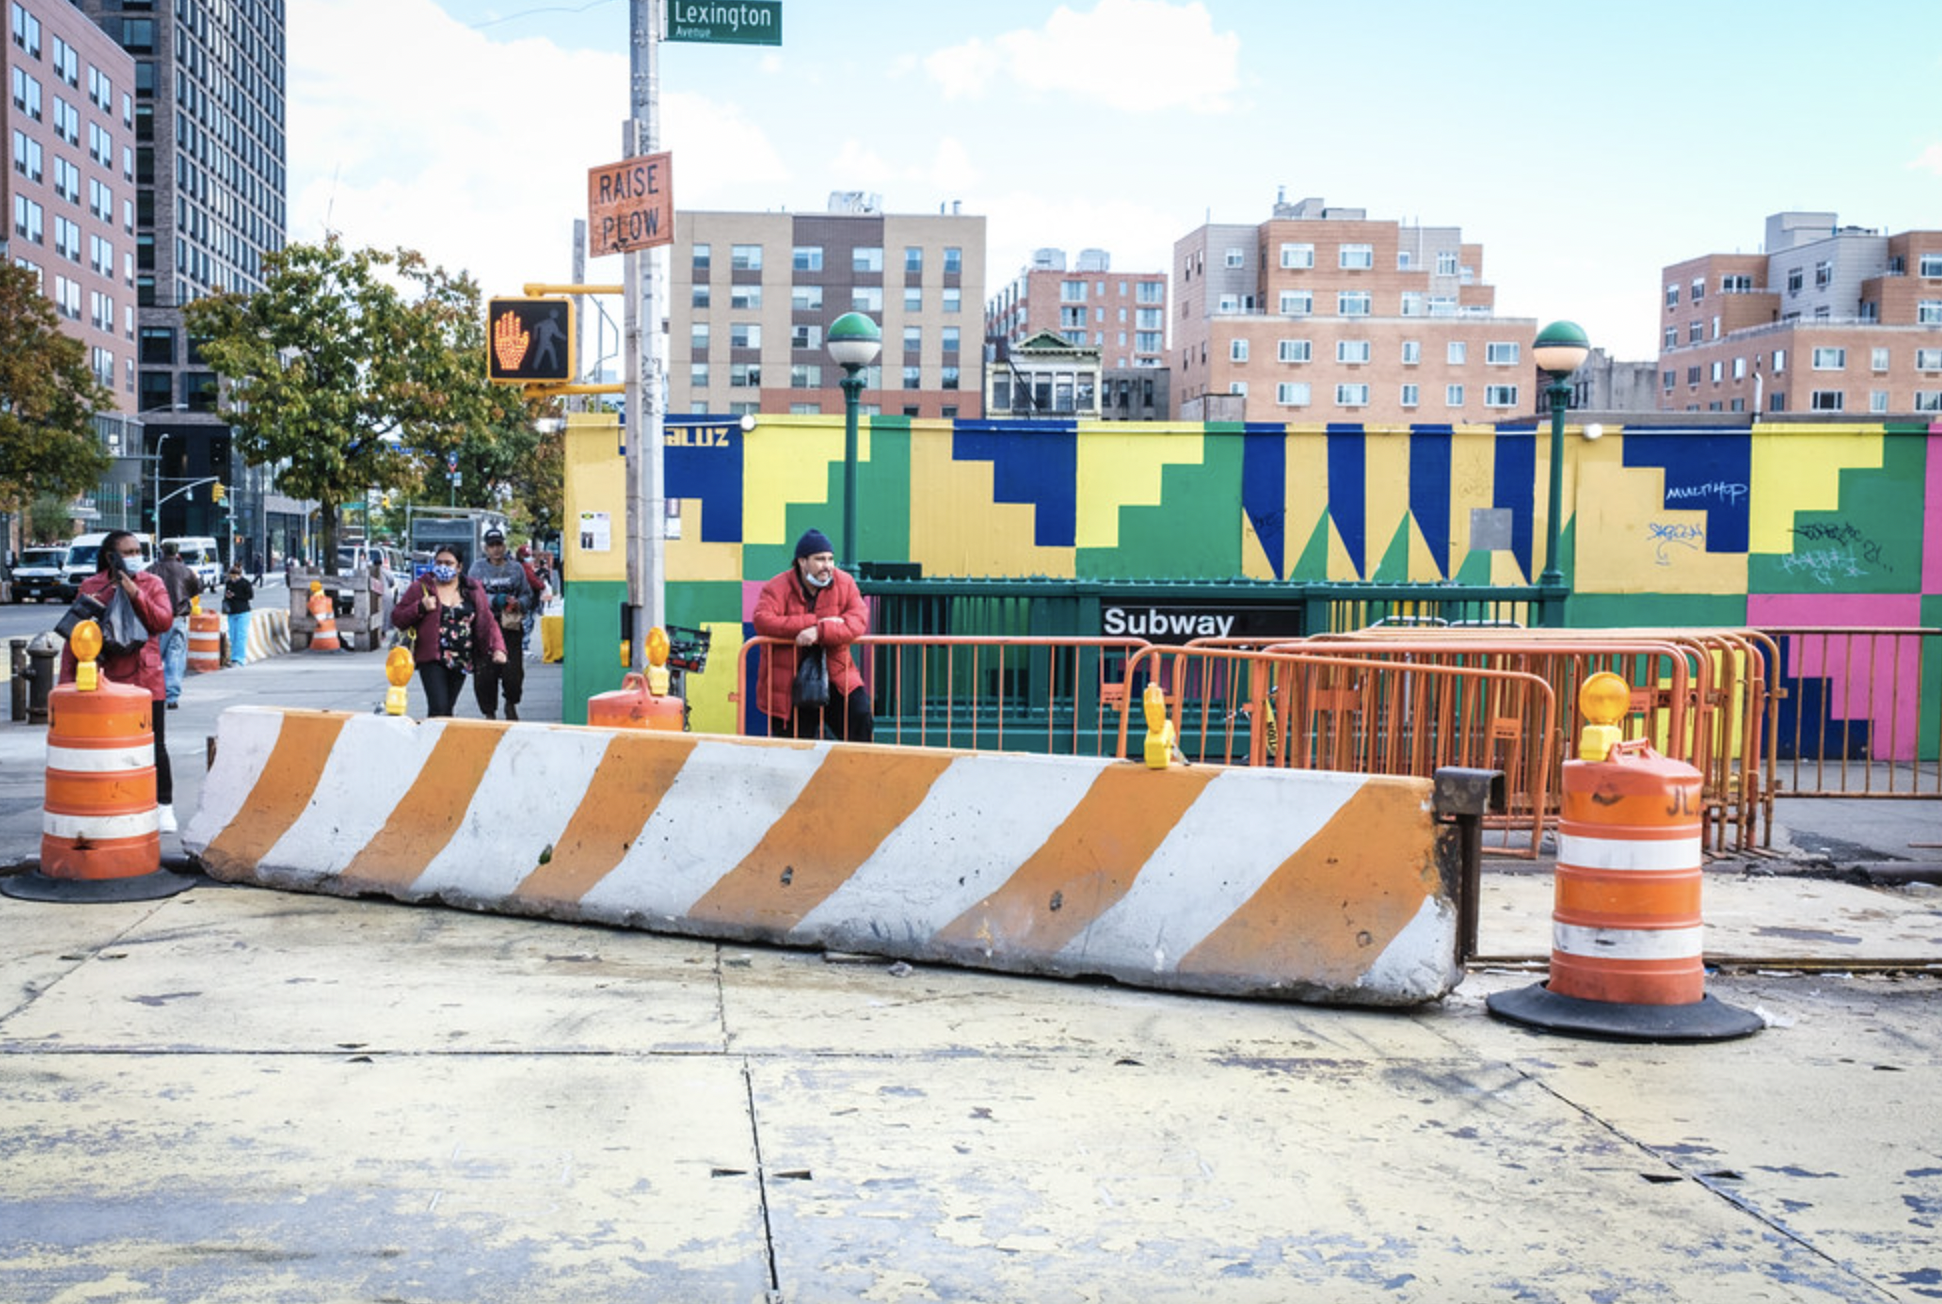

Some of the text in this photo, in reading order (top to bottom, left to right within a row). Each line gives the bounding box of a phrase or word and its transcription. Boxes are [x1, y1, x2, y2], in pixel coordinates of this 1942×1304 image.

[675, 1, 771, 32] Lexington
[676, 25, 711, 38] Avenue
[600, 164, 659, 204] RAISE
[603, 207, 659, 247] PLOW
[1104, 607, 1234, 638] Subway
